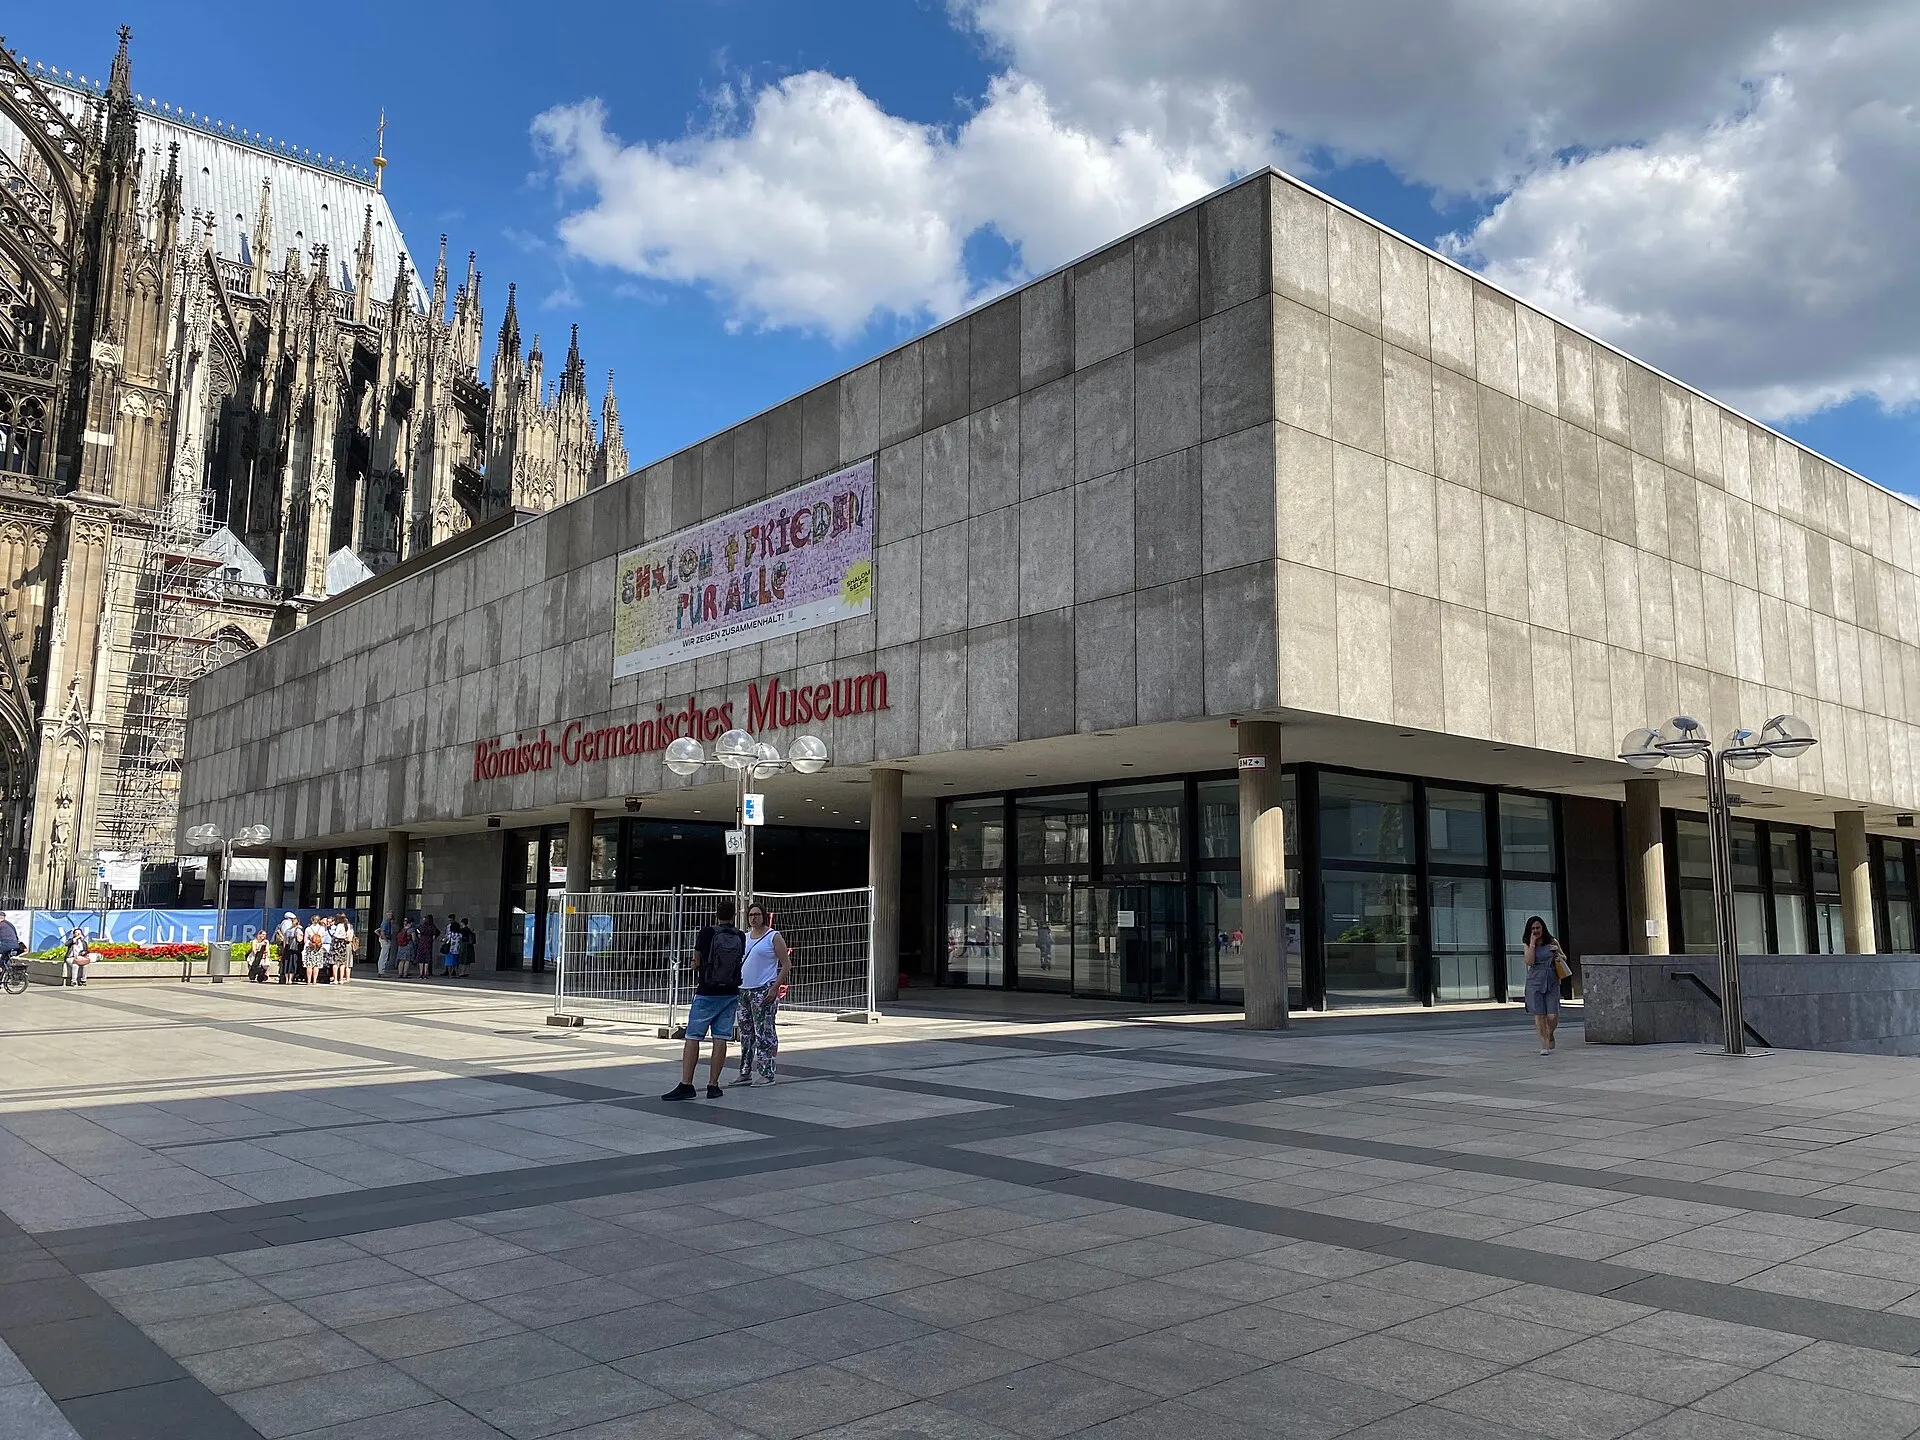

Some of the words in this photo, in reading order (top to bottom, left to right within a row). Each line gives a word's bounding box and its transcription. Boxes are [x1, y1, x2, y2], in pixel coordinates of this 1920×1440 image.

[723, 562, 788, 616] ALLE
[682, 637, 695, 648] WIR
[696, 632, 721, 644] ZEIGEN
[721, 613, 785, 637] ZUSAMMENHALT!
[472, 696, 734, 783] Römisch-Germanisches
[747, 671, 891, 735] Museum
